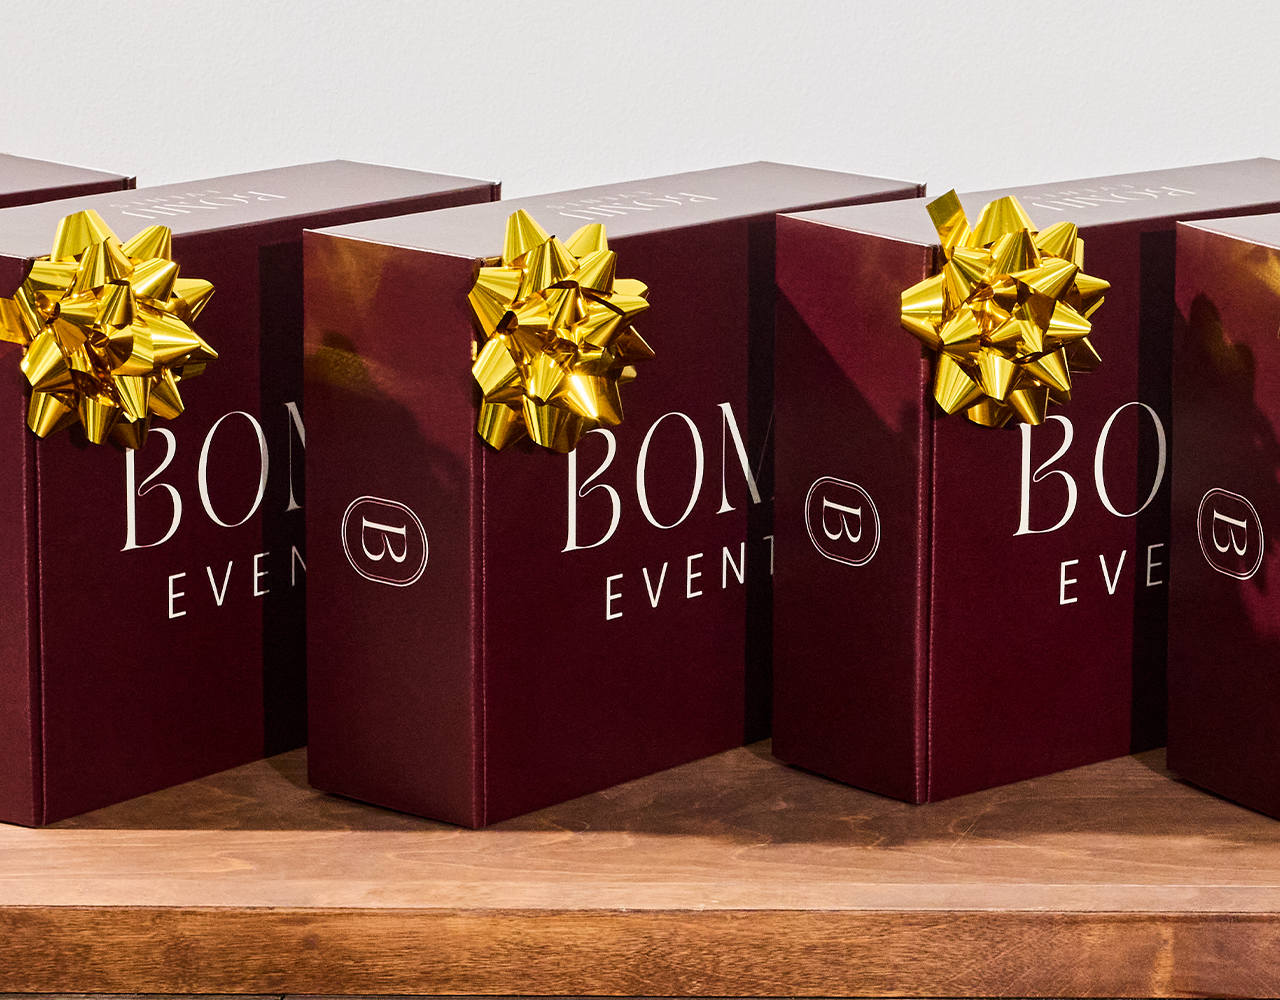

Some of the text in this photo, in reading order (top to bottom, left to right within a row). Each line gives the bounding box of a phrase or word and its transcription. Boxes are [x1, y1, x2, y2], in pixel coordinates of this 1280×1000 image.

[1013, 401, 1167, 537] BO
[362, 515, 408, 563] B
[822, 496, 862, 544] B
[1212, 511, 1248, 556] B
[1059, 543, 1165, 605] EVE
